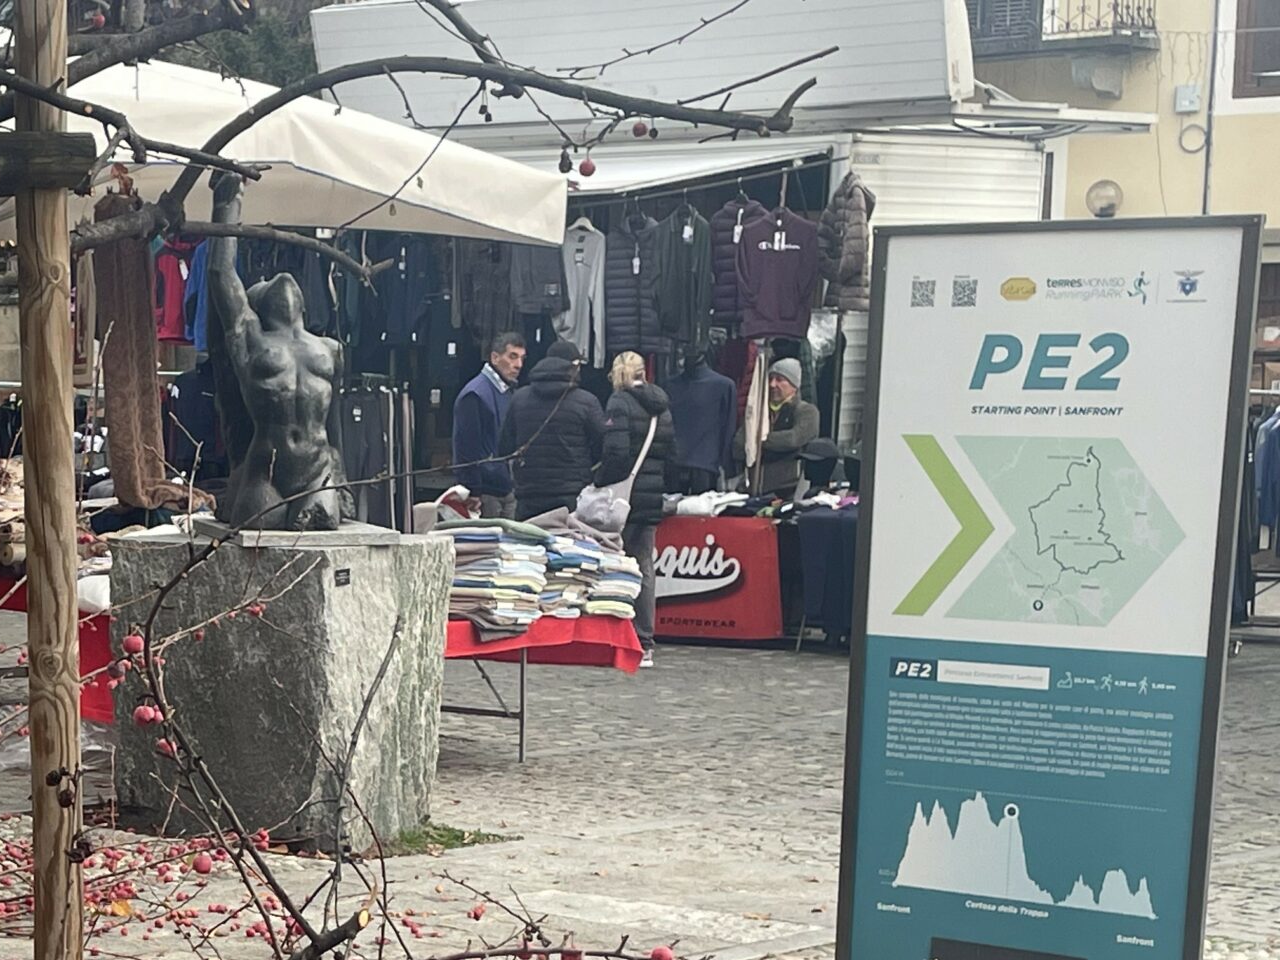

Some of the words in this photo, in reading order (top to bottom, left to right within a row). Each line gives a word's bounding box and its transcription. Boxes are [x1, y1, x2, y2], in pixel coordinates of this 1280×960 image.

[968, 332, 1130, 391] PE2
[970, 405, 1022, 416] STARTING
[1023, 405, 1057, 417] POINT
[1064, 406, 1124, 418] SANFRONT
[659, 617, 737, 629] SPORTSWEAR
[894, 661, 933, 678] PE2
[876, 901, 911, 914] Sanfront
[964, 899, 997, 912] Certosa
[997, 904, 1018, 914] della
[1019, 906, 1049, 918] Trappa
[1116, 933, 1155, 948] Sanfront
